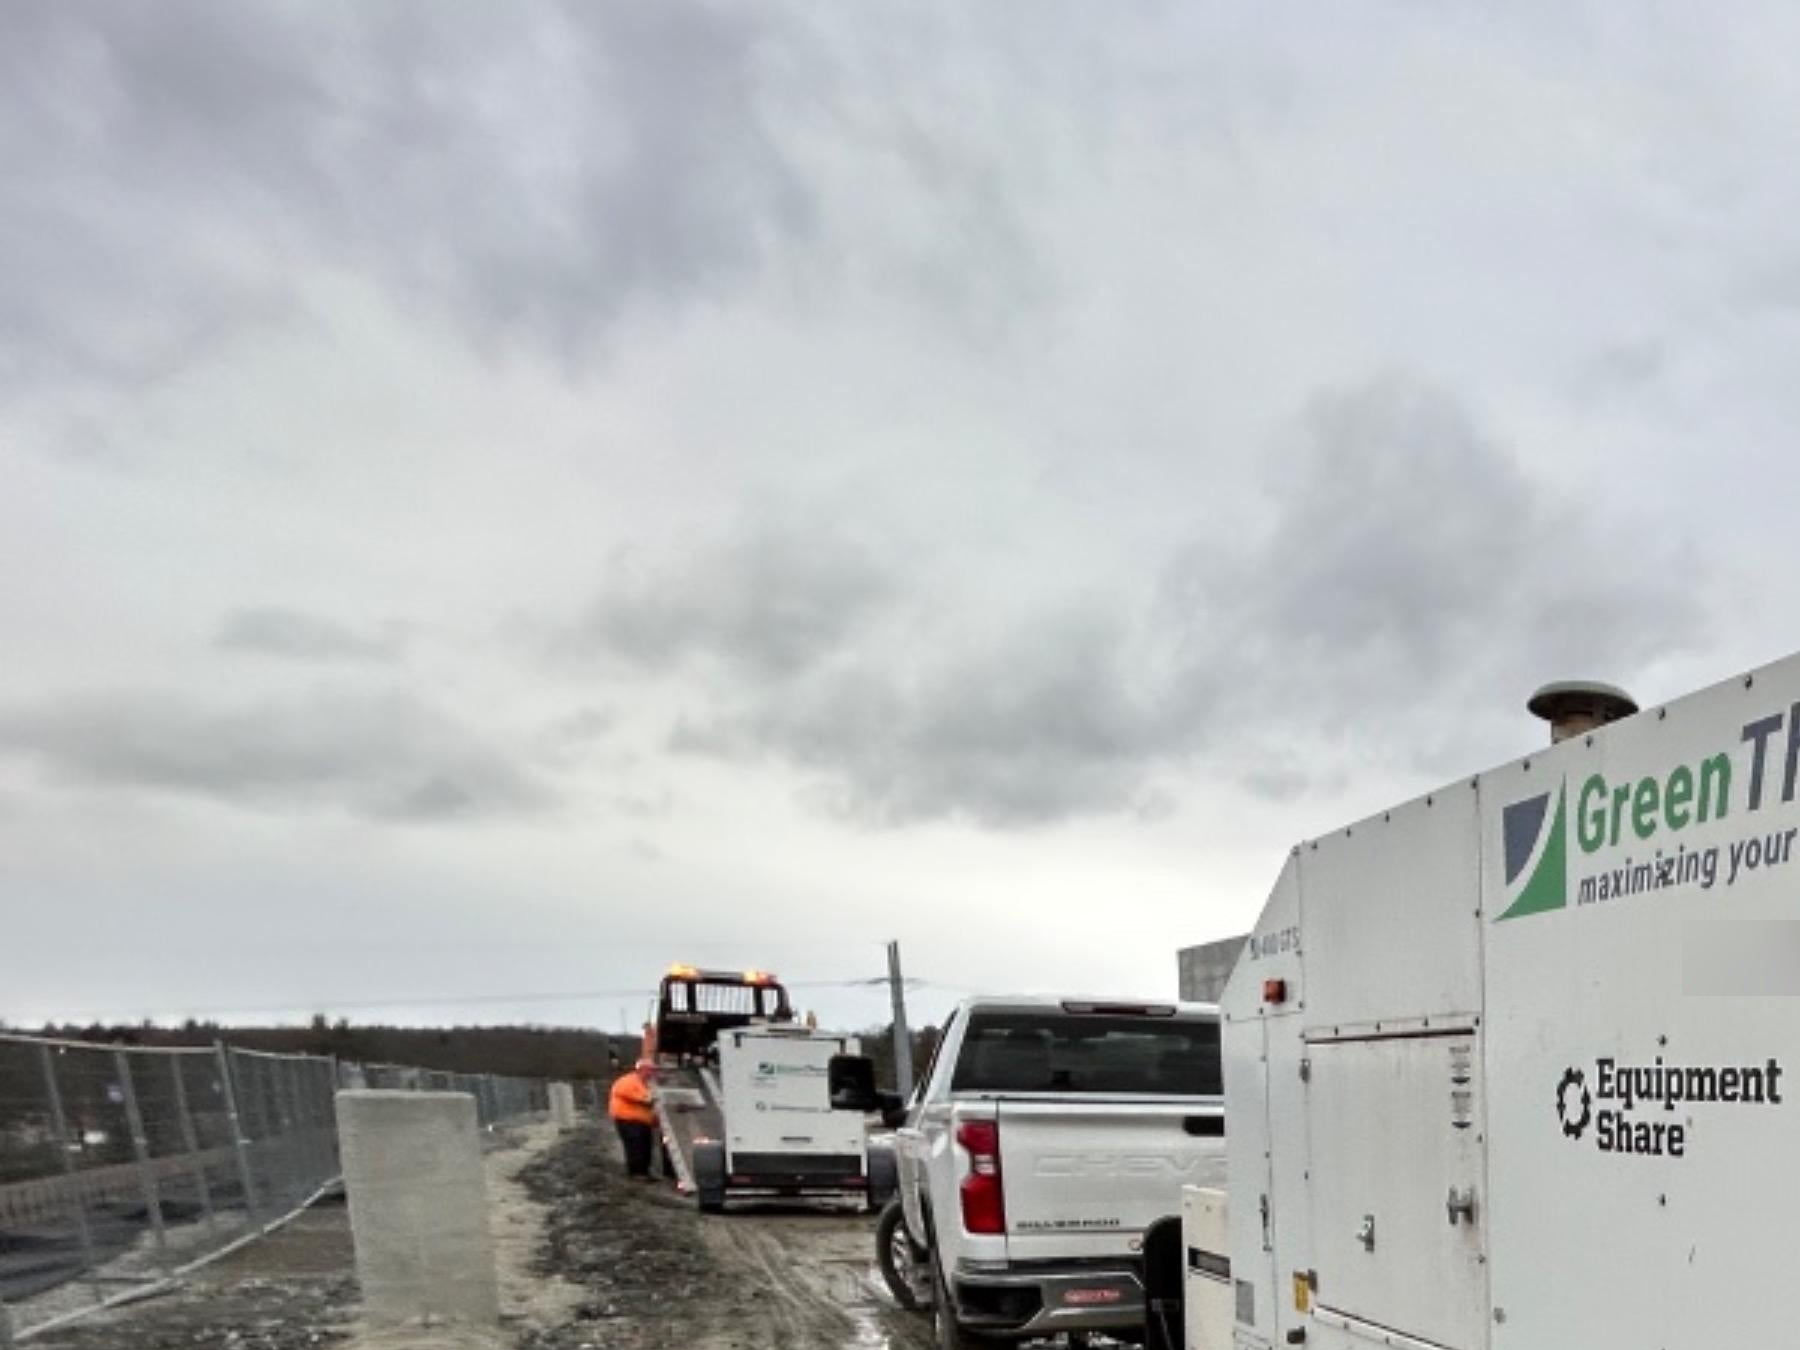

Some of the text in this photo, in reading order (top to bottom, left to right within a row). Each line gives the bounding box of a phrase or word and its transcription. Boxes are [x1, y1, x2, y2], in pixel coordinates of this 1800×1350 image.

[1579, 844, 1717, 906] maximizing
[1727, 827, 1797, 885] your
[1596, 1057, 1783, 1111] Equipment
[1597, 1110, 1685, 1158] Share
